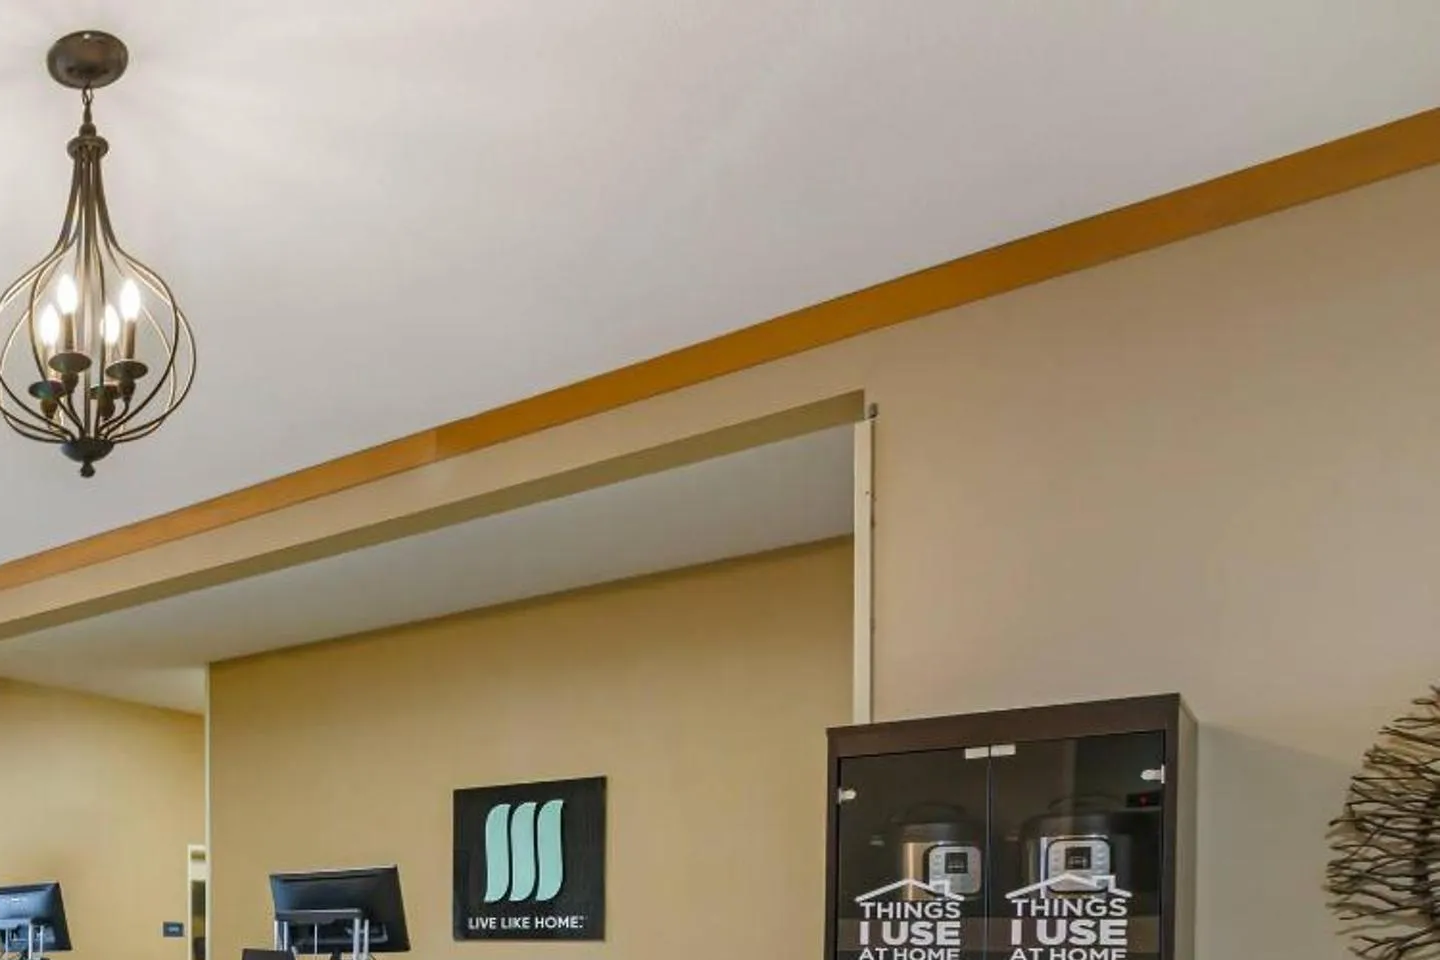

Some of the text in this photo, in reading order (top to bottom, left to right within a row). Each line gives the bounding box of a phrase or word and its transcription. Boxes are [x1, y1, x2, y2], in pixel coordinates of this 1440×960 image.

[860, 902, 961, 919] THINGS
[1011, 898, 1128, 917] THINGS
[468, 917, 497, 930] LIVE
[501, 917, 531, 930] LIKE
[1011, 919, 1128, 946] I USE
[860, 921, 961, 946] I USE
